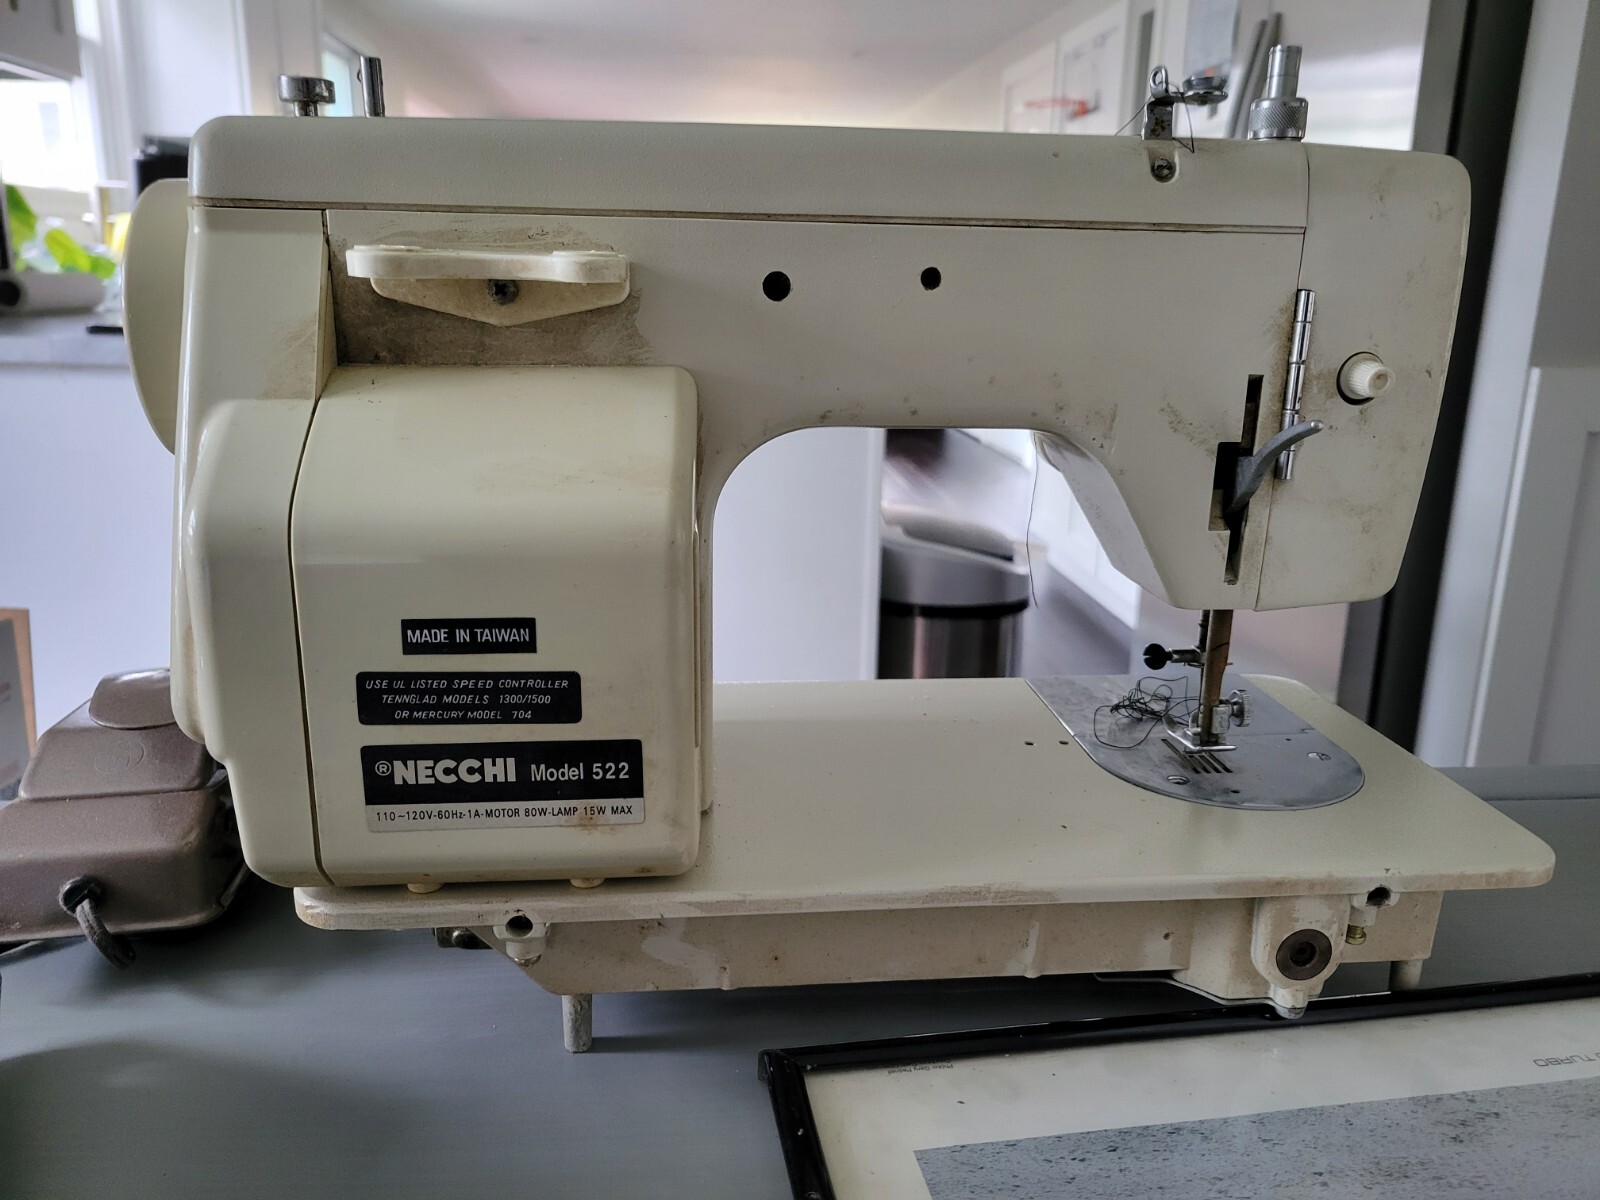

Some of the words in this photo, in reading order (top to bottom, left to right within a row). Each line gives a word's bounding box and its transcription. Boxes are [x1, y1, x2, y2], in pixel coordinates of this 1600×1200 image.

[407, 628, 450, 643] MADE
[455, 628, 470, 643] IN
[473, 628, 530, 642] TAIWAN
[365, 679, 389, 689] USE
[392, 679, 406, 689] UL
[410, 679, 448, 689] LISTED
[452, 679, 494, 689] SPEED
[498, 679, 569, 689] CONTROLLER
[381, 694, 438, 704] TENNGLAD
[442, 694, 490, 704] MODELS
[499, 694, 551, 704] 1300/1500
[394, 710, 410, 719] OR
[412, 710, 465, 719] MERCURY
[466, 710, 503, 719] MODEL
[511, 710, 532, 719] 704
[530, 762, 584, 782] Model
[592, 762, 630, 780] 522
[583, 806, 607, 816] 15W
[610, 805, 633, 815] MAX
[1532, 1054, 1597, 1067] TURBO
